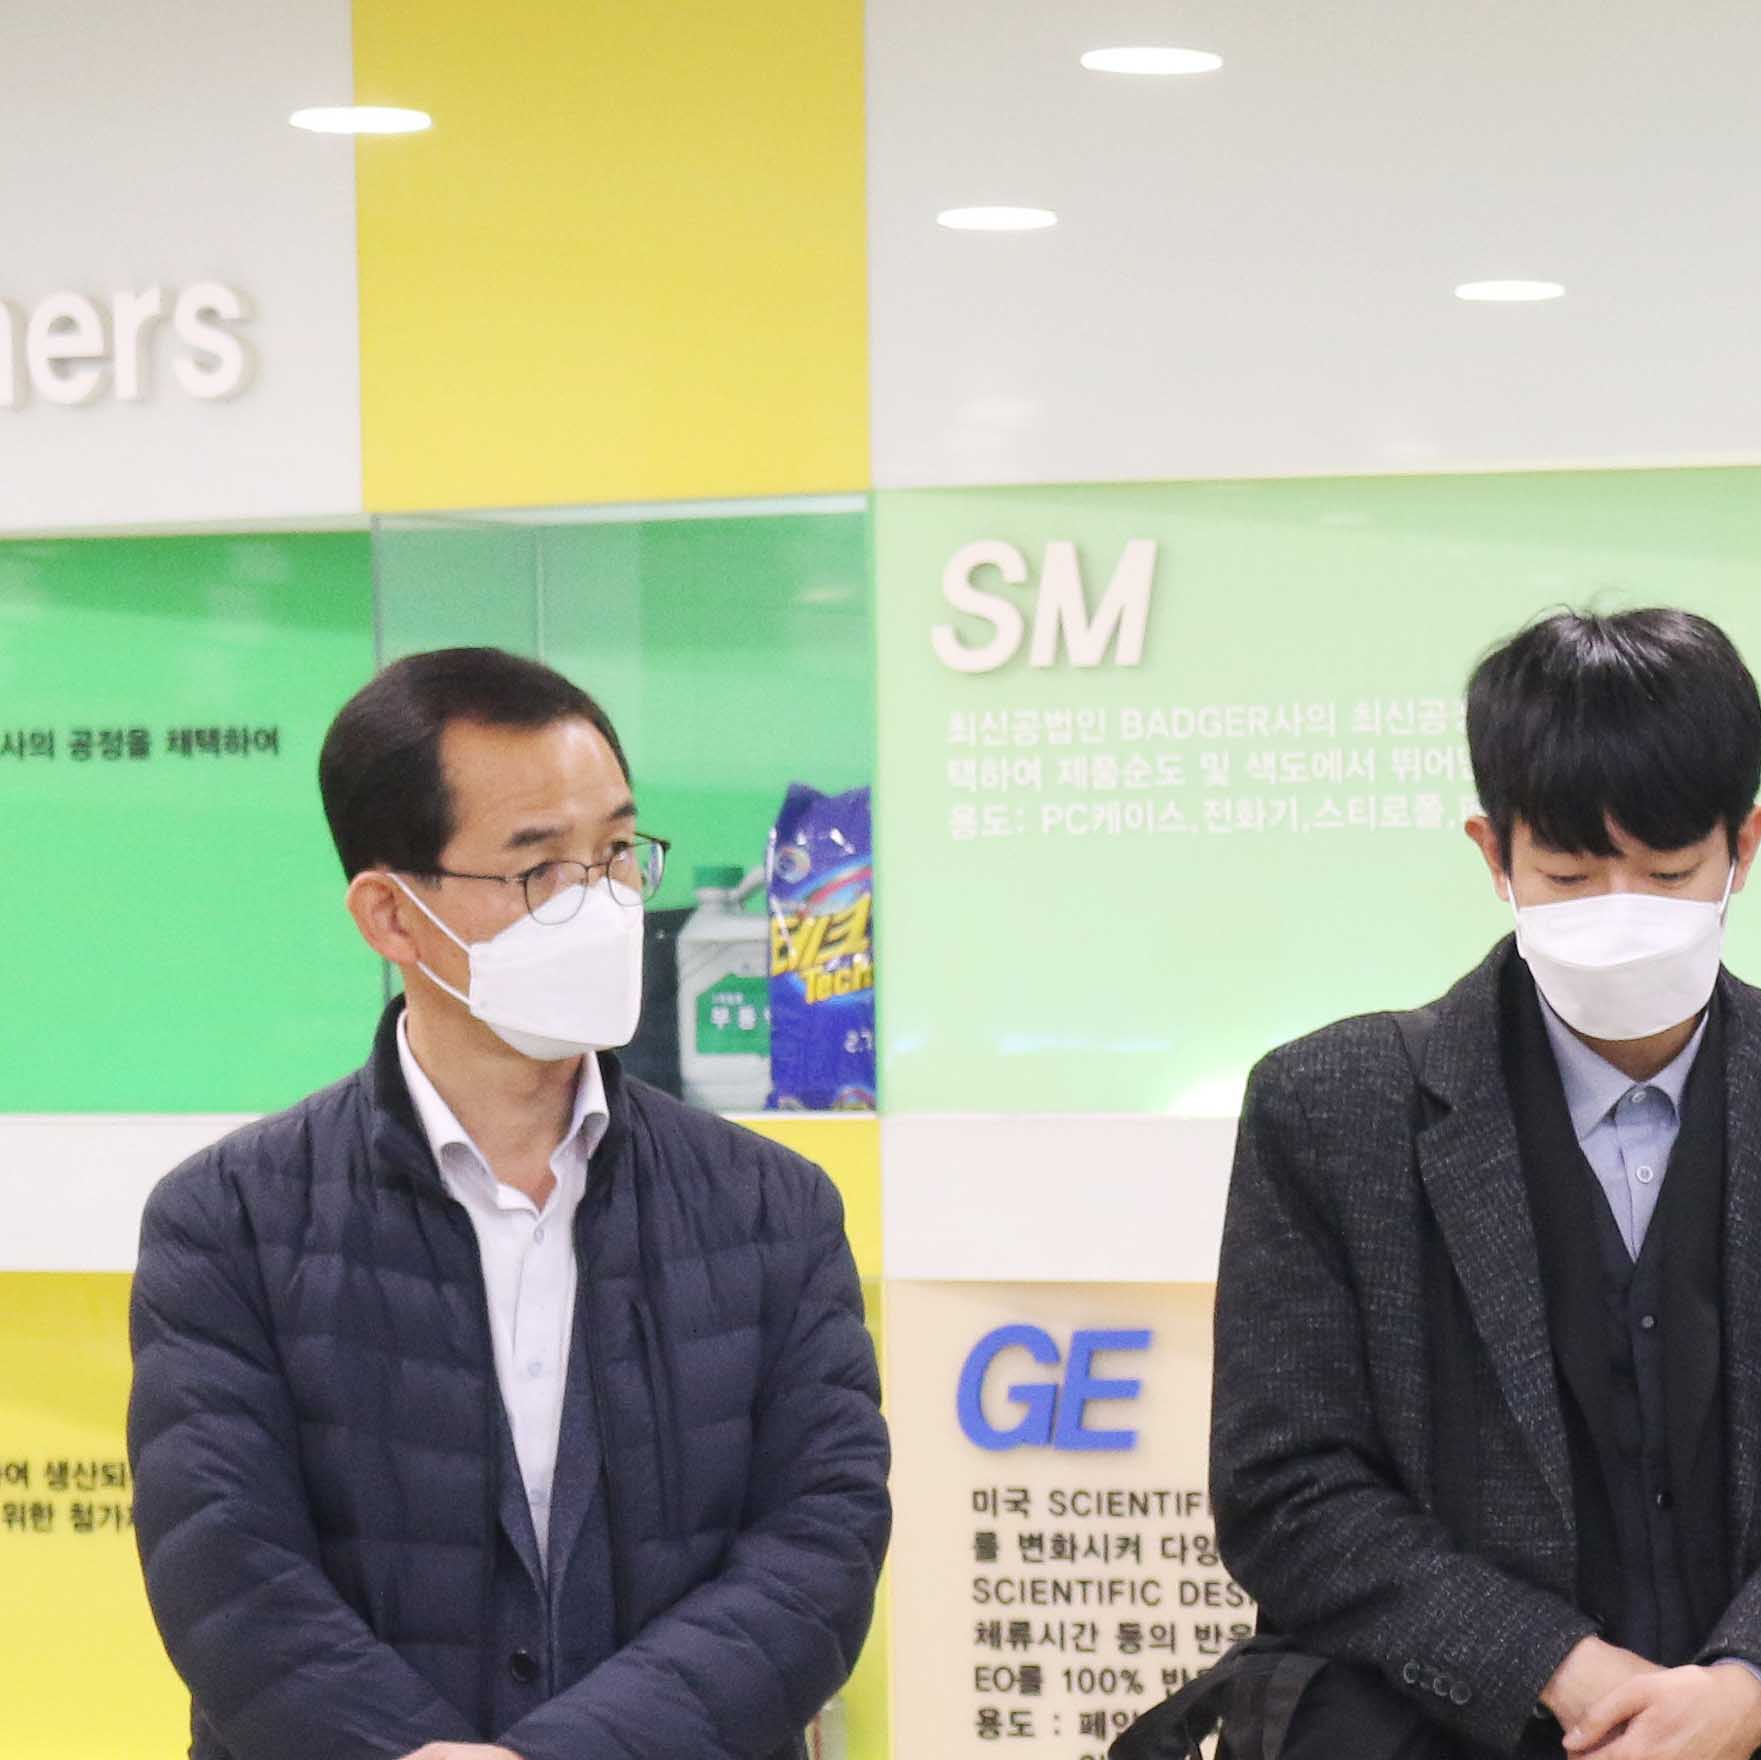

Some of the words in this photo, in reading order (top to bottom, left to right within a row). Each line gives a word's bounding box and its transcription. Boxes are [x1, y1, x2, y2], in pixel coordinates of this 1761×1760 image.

[0, 279, 250, 405] ers
[931, 538, 1160, 674] SM
[1118, 701, 1336, 744] BADGER사의
[68, 727, 152, 762] 공정을
[957, 1322, 1153, 1453] GE
[70, 1502, 134, 1534] 첨가
[973, 1487, 1032, 1519] 미국
[1018, 1531, 1142, 1565] 변화시켜
[972, 1576, 1162, 1607] SCIENTIFIC
[1178, 1579, 1257, 1608] DES
[1062, 1666, 1145, 1696] 100%
[976, 1707, 1035, 1741] 용도
